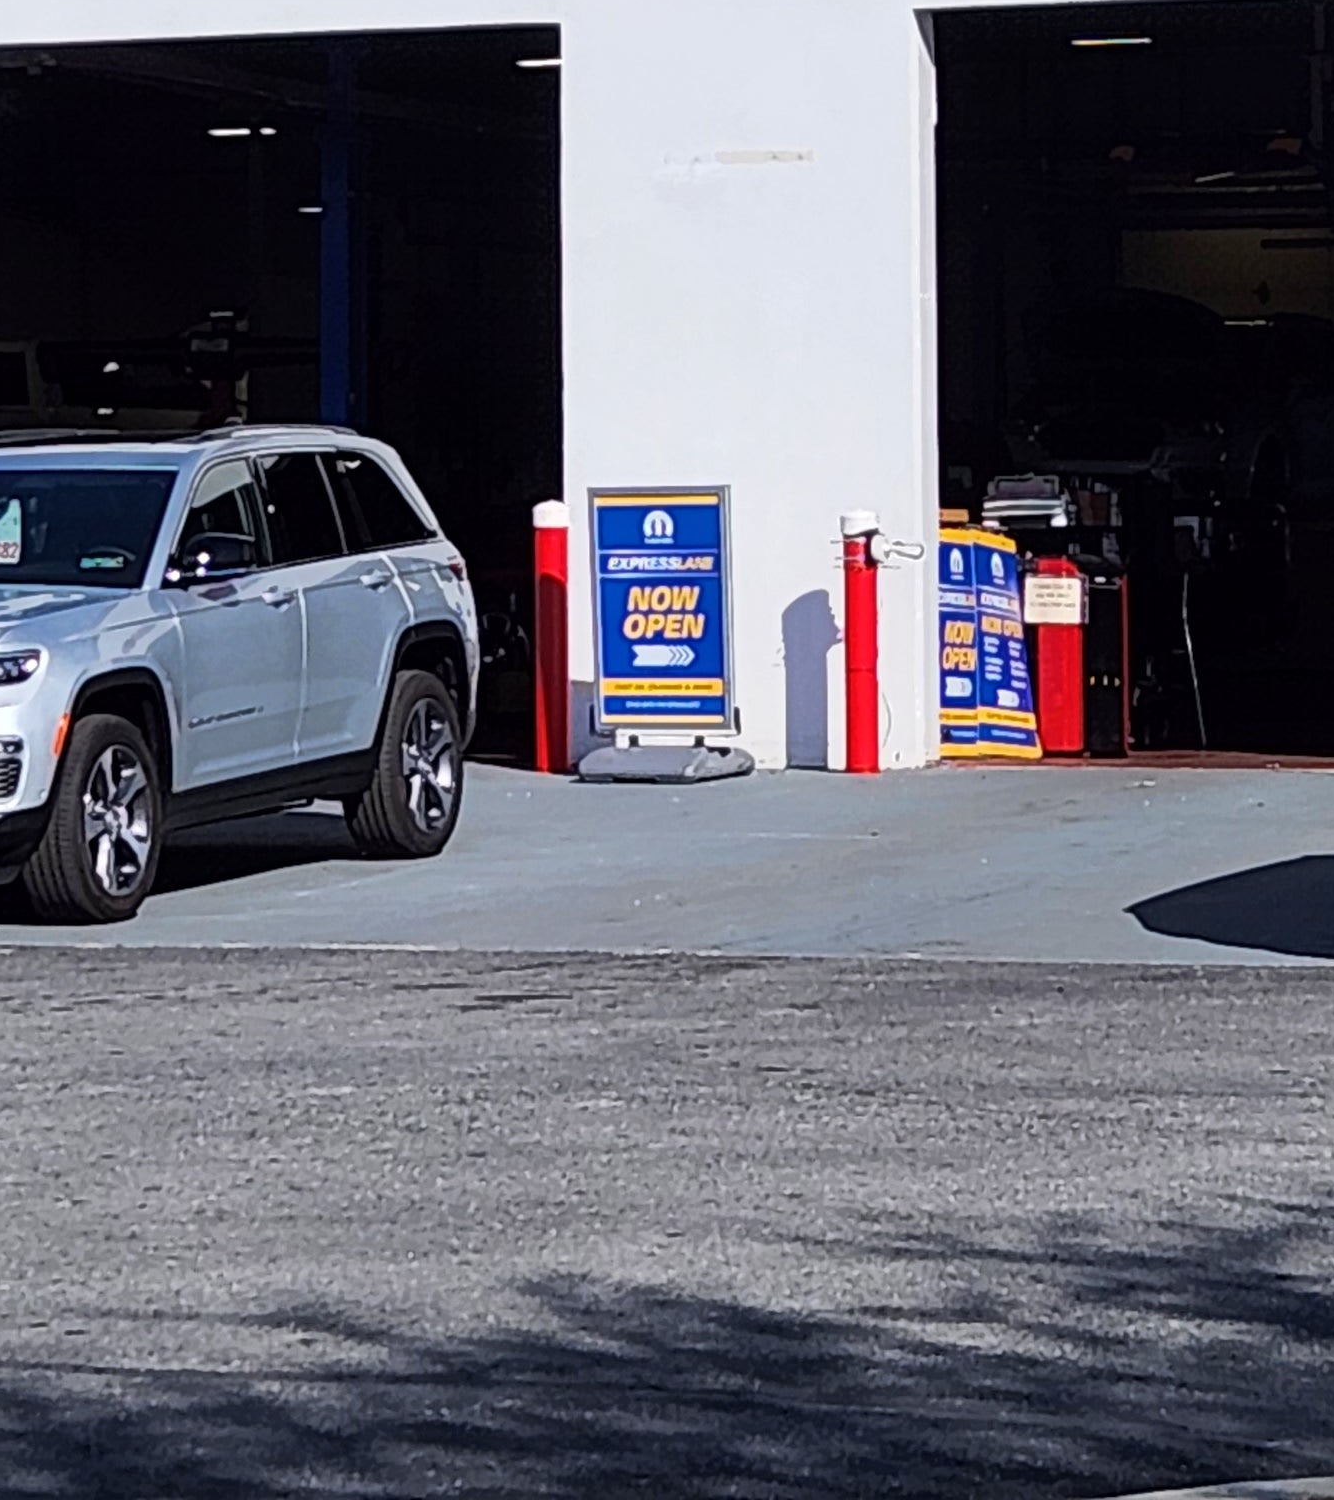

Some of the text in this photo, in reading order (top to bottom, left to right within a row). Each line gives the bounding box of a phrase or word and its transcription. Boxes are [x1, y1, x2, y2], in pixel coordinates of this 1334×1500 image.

[627, 585, 700, 612] NOW
[622, 613, 705, 639] OPEN
[944, 621, 975, 645] NOW
[942, 646, 976, 671] OPEN
